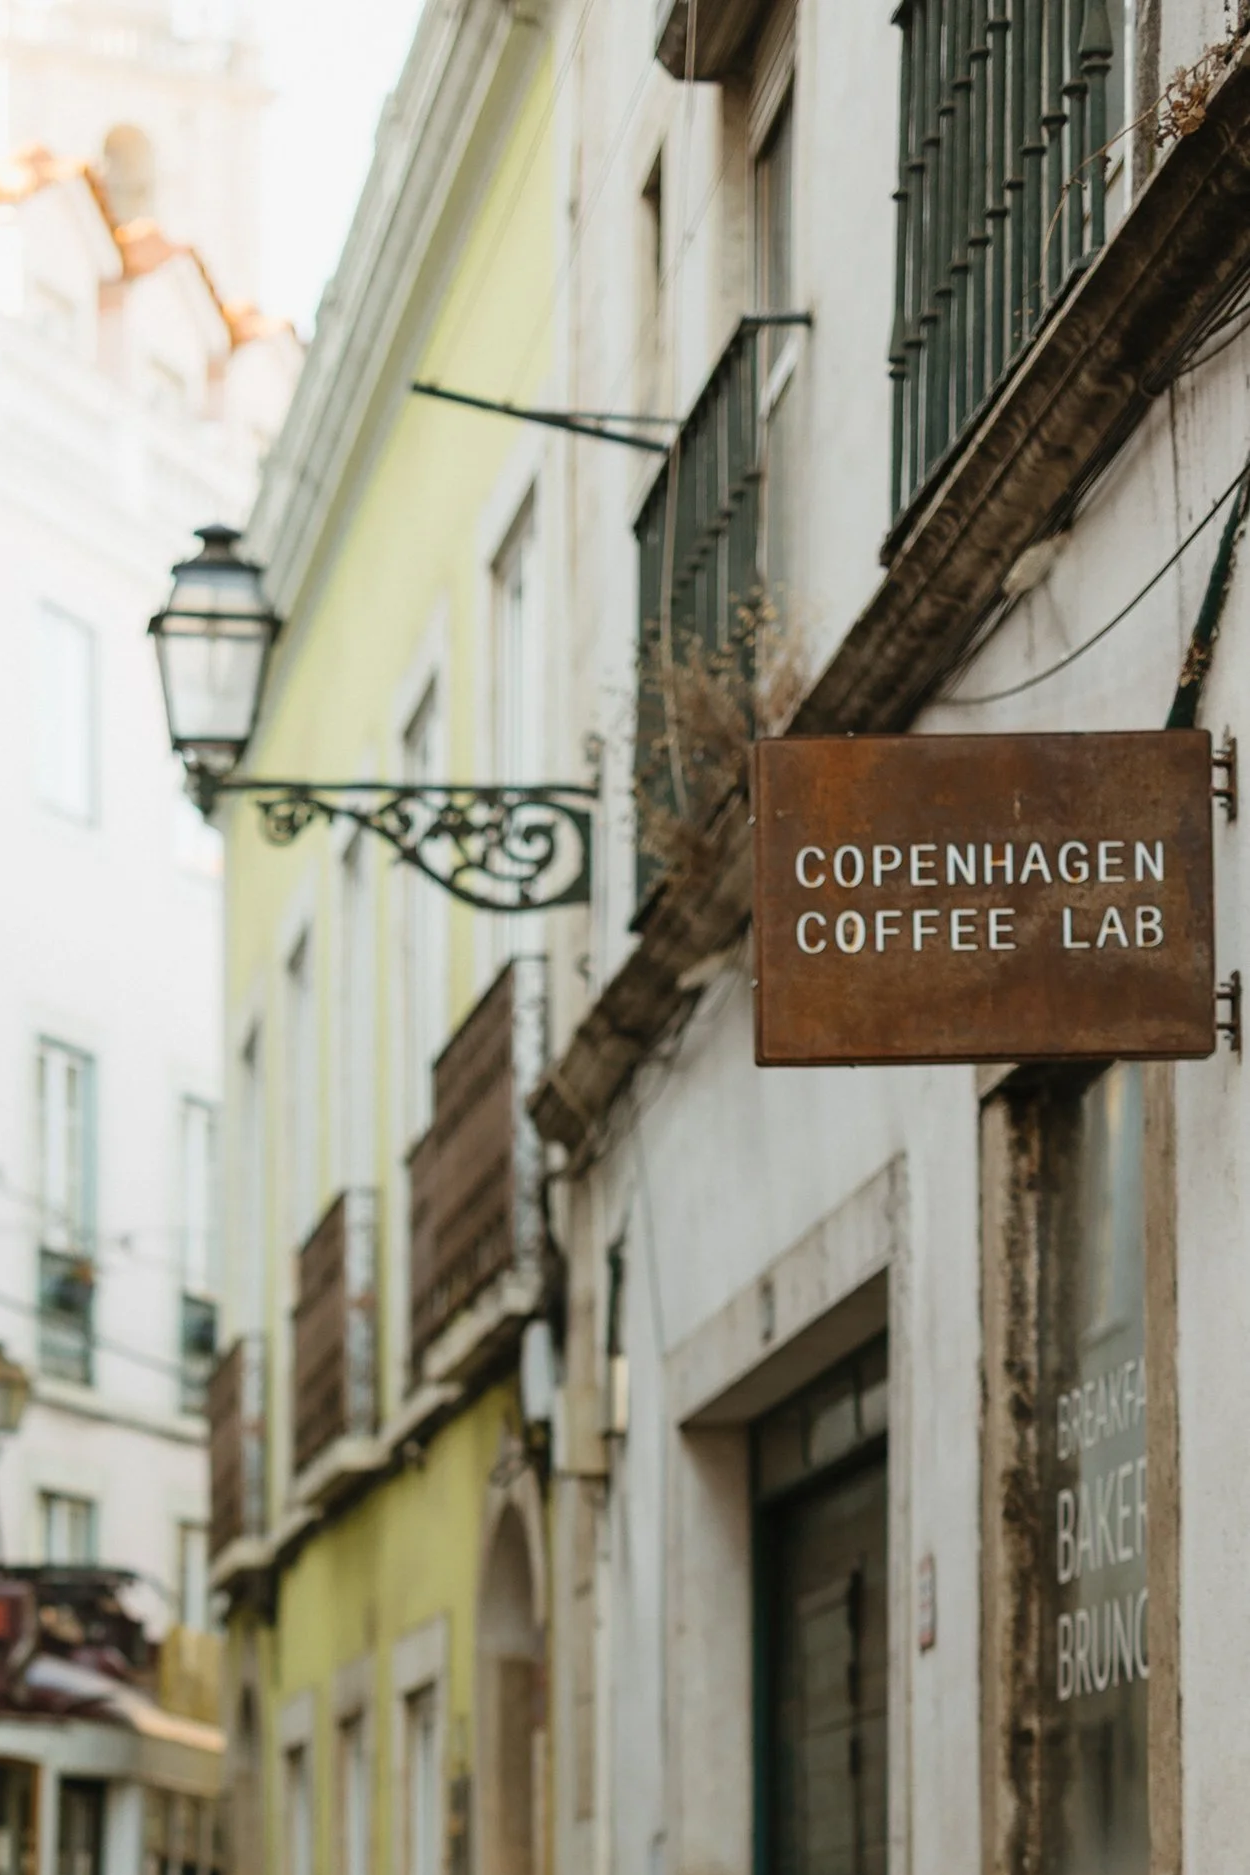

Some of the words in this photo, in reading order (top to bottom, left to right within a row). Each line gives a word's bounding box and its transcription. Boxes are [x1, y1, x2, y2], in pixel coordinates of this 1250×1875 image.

[795, 841, 1165, 888] COPENHAGEN
[796, 906, 1016, 954] COFFEE
[1062, 906, 1164, 949] LAB
[1057, 1586, 1150, 1701] BRUNC
